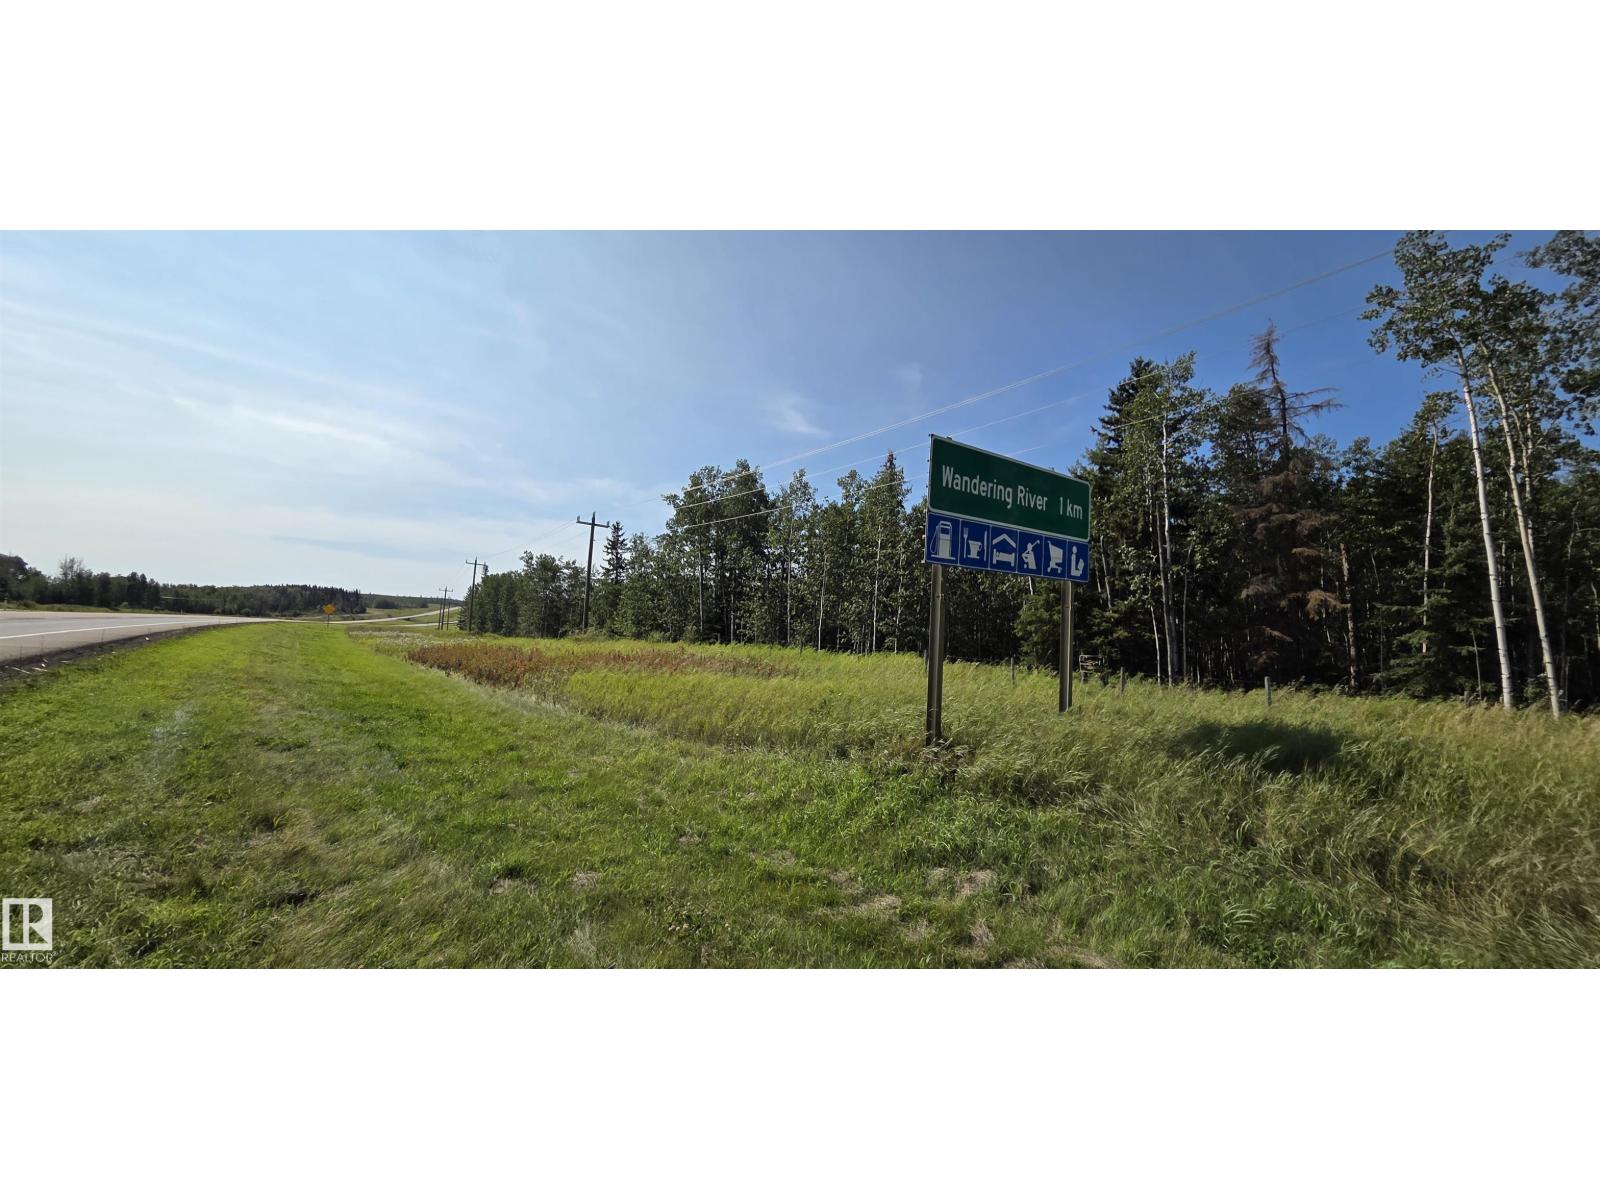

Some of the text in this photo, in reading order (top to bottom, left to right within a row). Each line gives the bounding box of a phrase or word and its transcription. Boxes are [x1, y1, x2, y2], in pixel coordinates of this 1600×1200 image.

[942, 464, 1083, 520] Wandering River 1 km
